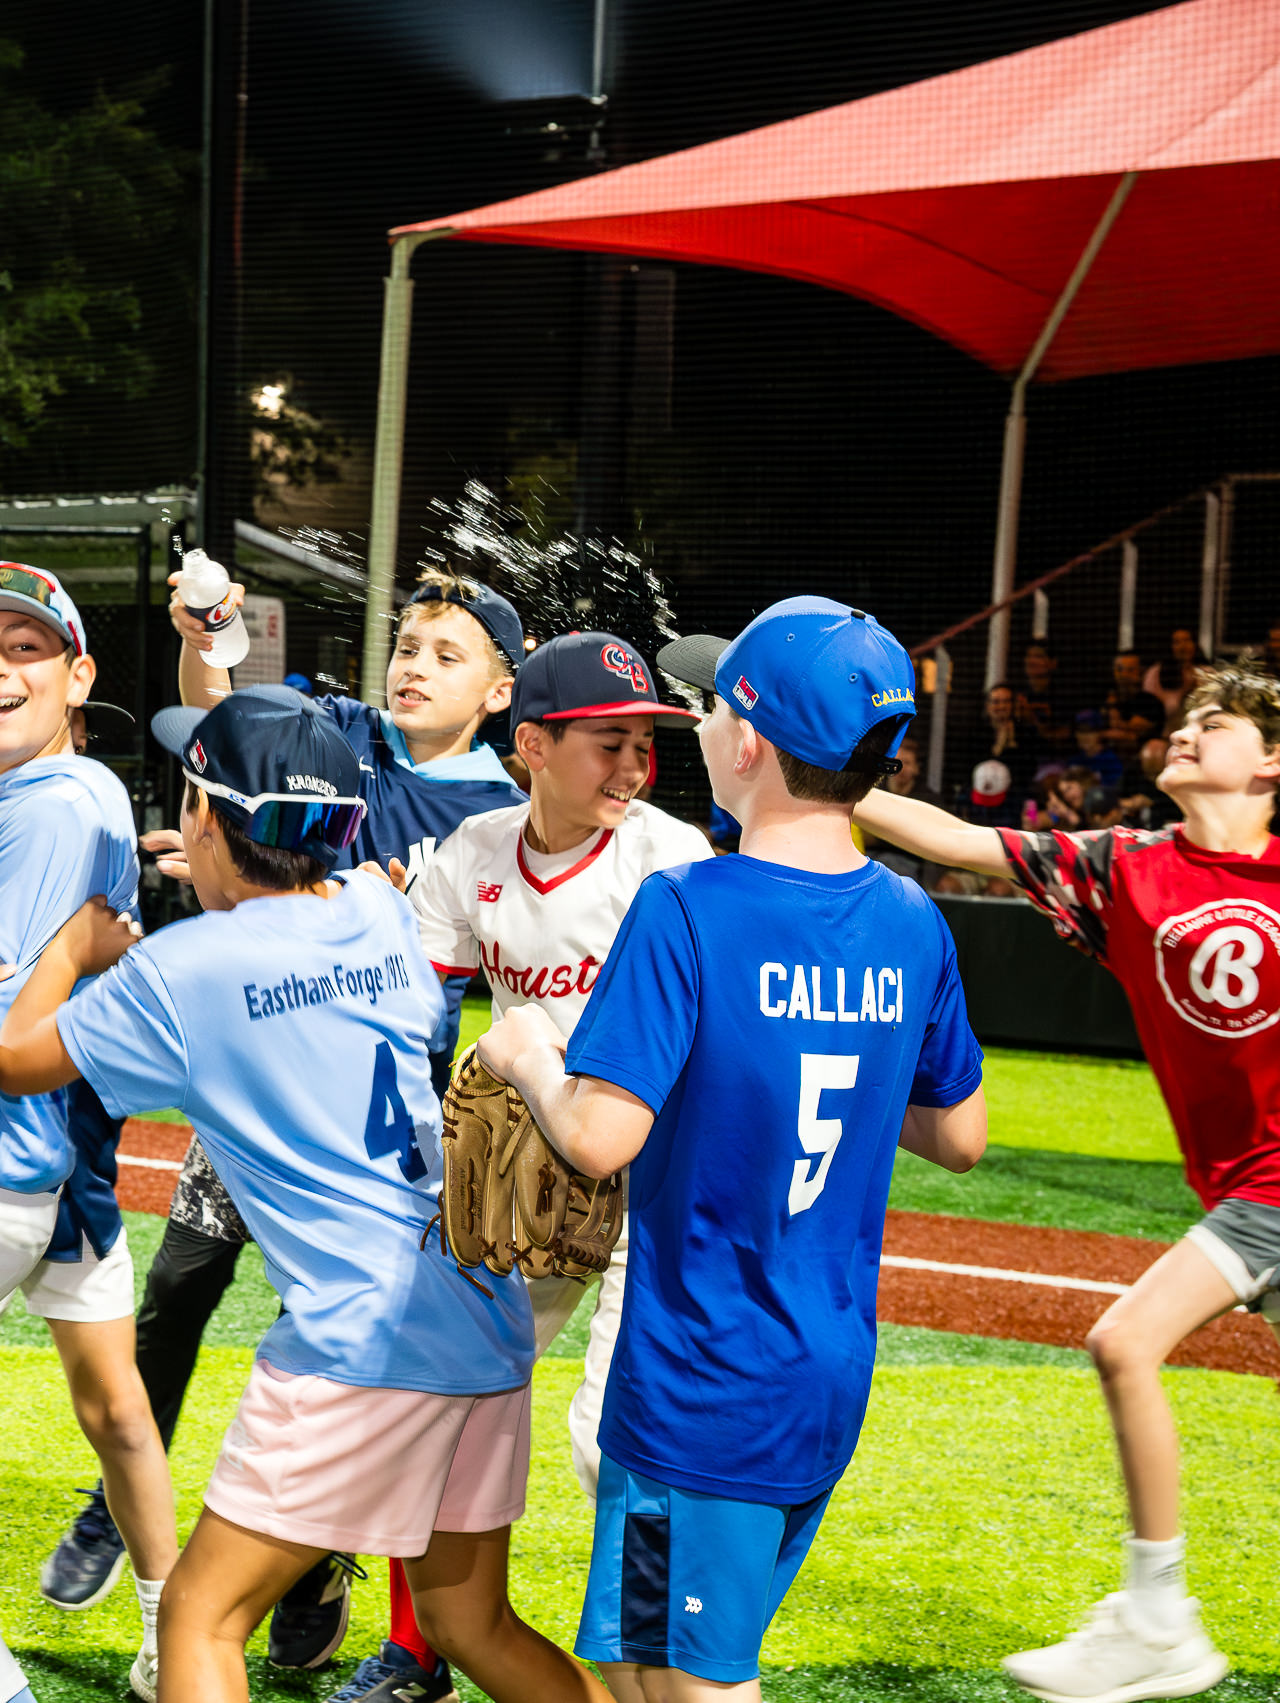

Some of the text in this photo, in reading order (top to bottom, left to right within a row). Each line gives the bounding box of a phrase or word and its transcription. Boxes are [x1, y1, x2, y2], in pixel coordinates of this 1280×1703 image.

[242, 972, 338, 1022] Eastham
[332, 964, 385, 1006] Forge
[759, 961, 904, 1024] CALLACI
[1188, 925, 1265, 1010] B
[363, 1040, 429, 1184] 4
[787, 1052, 861, 1217] 5
